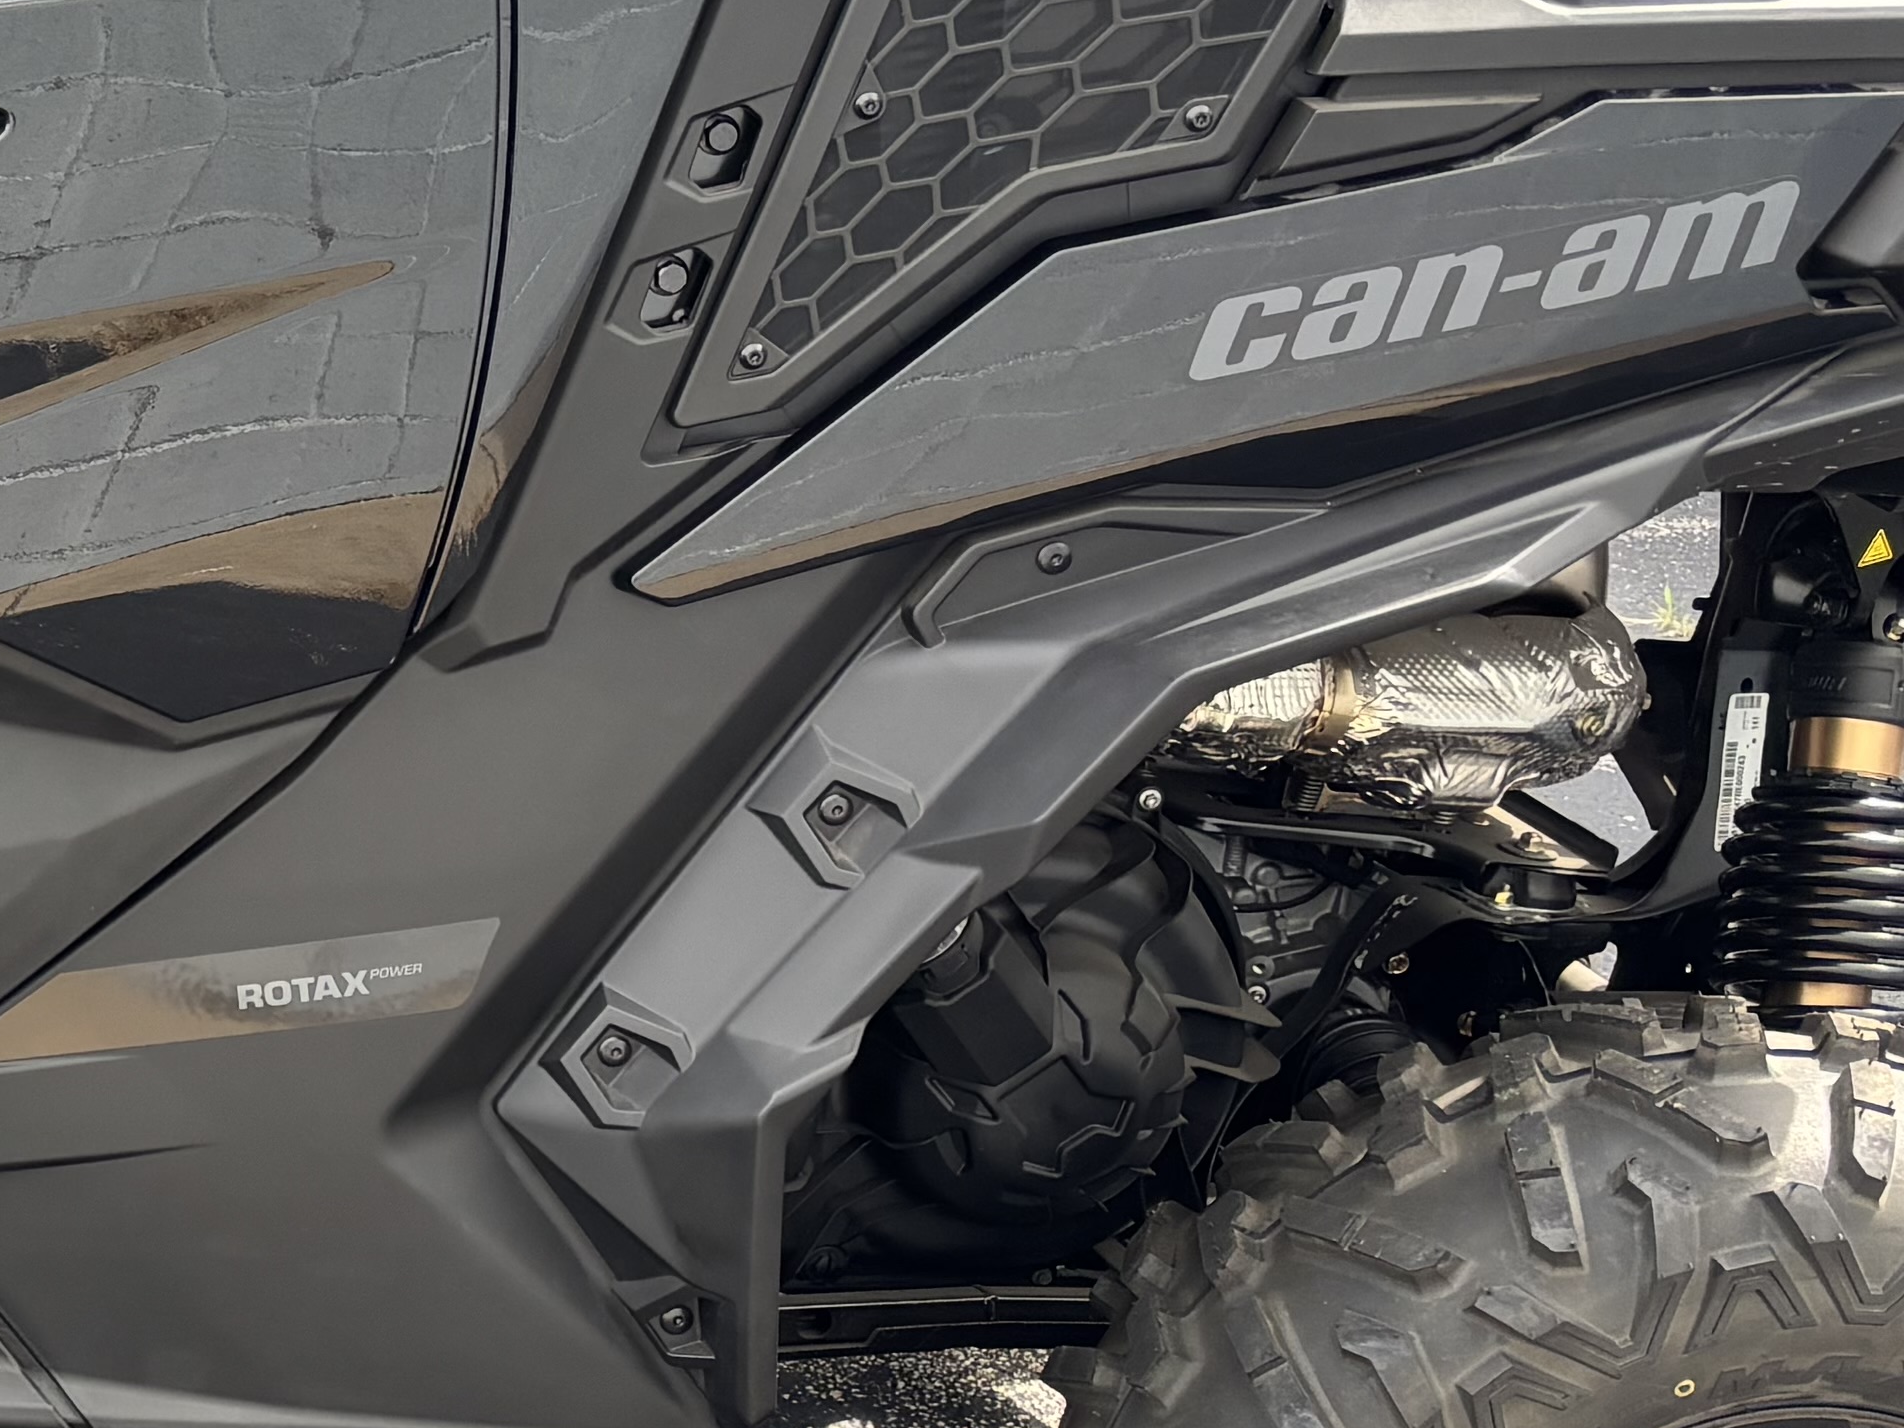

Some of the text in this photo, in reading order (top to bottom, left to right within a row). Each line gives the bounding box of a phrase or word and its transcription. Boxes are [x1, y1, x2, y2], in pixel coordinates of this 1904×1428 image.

[1188, 180, 1801, 382] can-am
[236, 963, 423, 1011] ROTAX POWER
